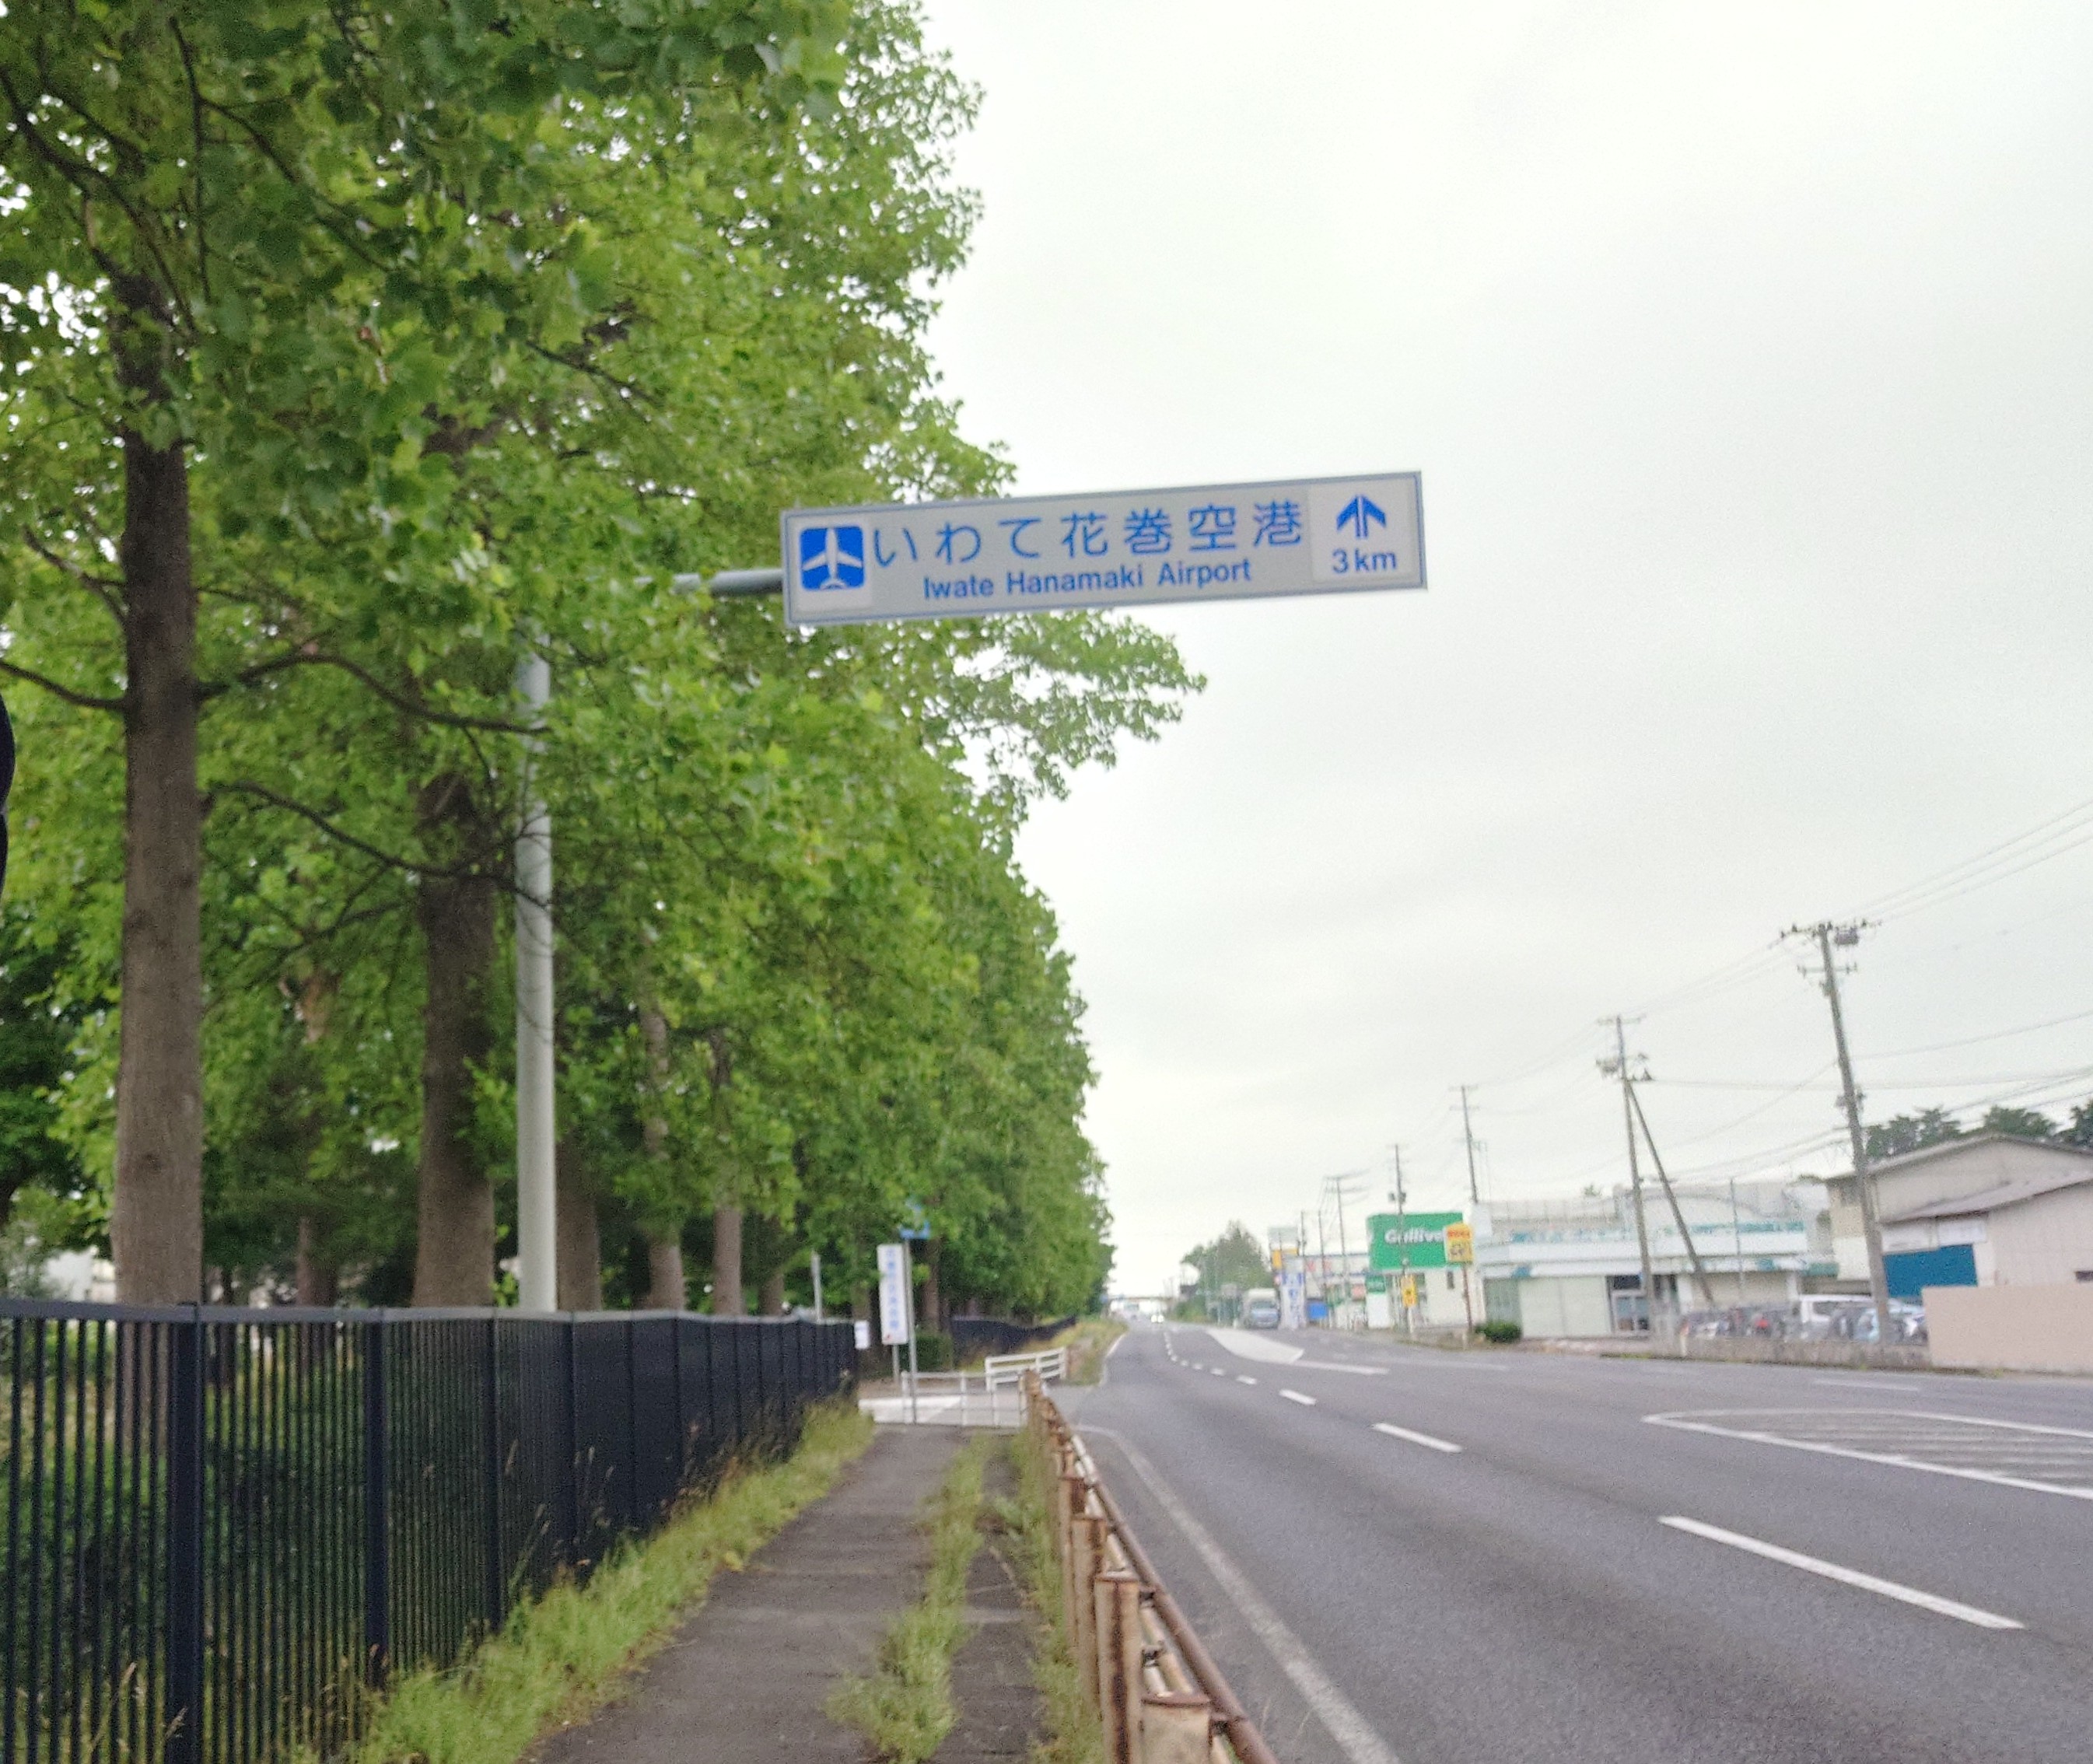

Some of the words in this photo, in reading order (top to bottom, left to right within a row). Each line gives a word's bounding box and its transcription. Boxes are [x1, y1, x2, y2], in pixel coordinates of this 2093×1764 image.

[873, 499, 1303, 567] いわて花巻空港
[923, 574, 994, 600] Iwate
[1006, 564, 1143, 594] Hanamaki
[1157, 558, 1251, 588] Airport
[1384, 1227, 1445, 1244] Gullive
